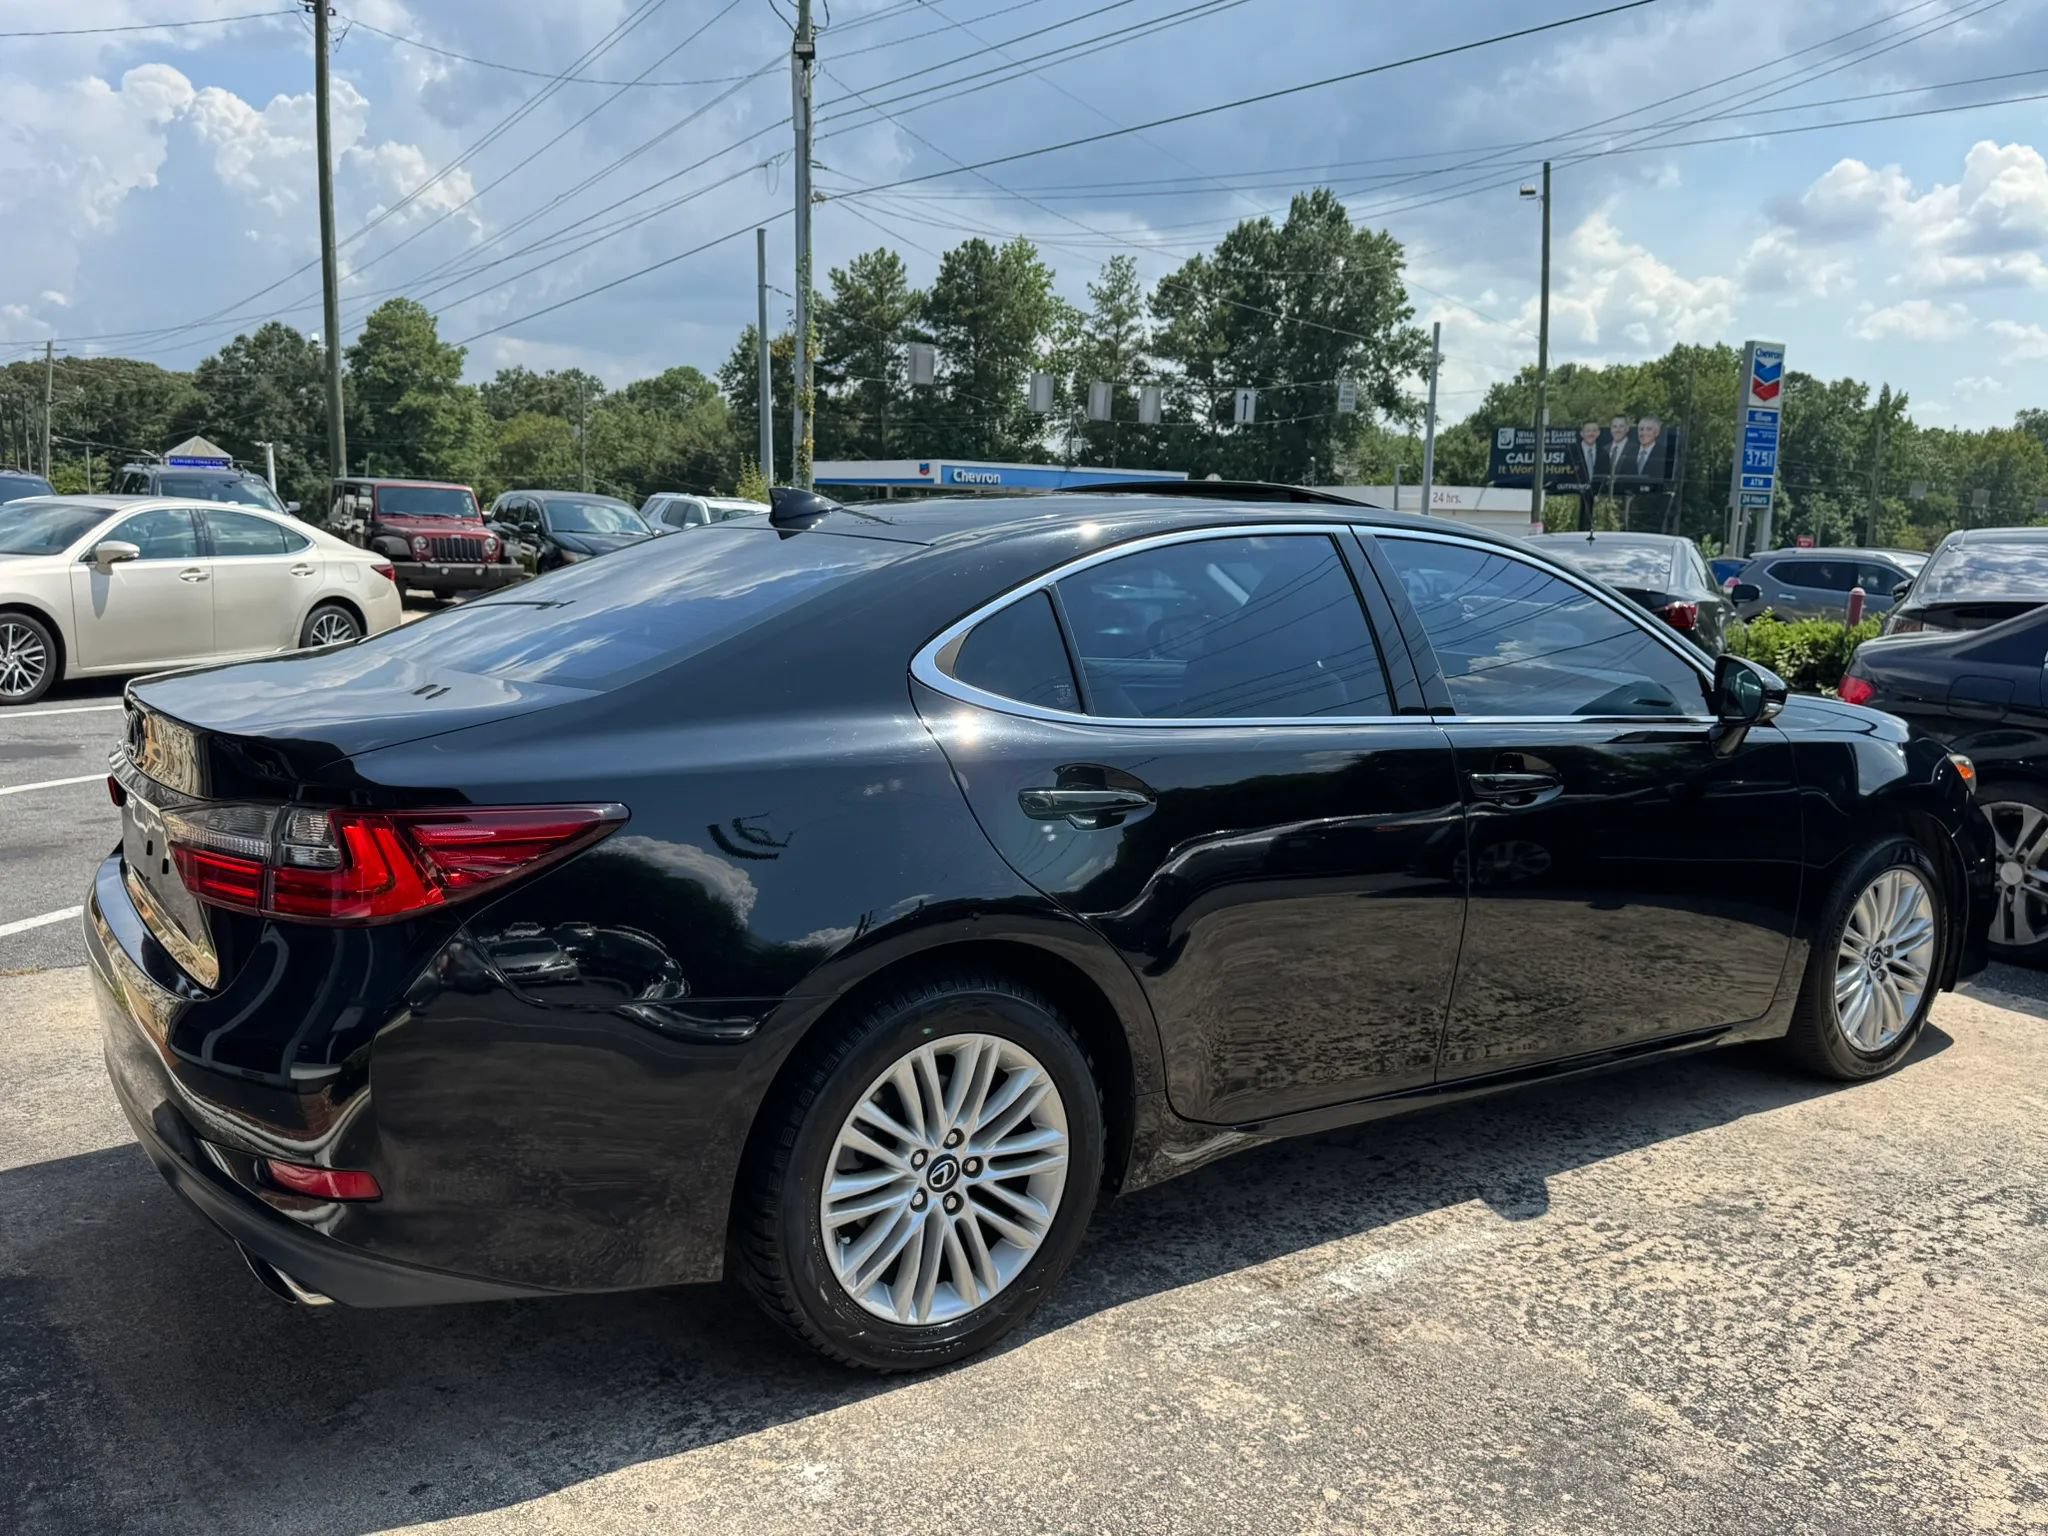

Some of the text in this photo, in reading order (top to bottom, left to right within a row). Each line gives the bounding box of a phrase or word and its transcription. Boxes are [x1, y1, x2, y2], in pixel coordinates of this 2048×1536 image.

[1755, 347, 1783, 358] Chevron
[1543, 452, 1565, 464] US!
[1498, 465, 1506, 474] It
[953, 469, 1001, 484] Chevron
[1750, 478, 1764, 487] ATM
[1432, 492, 1462, 503] 24 hrs.
